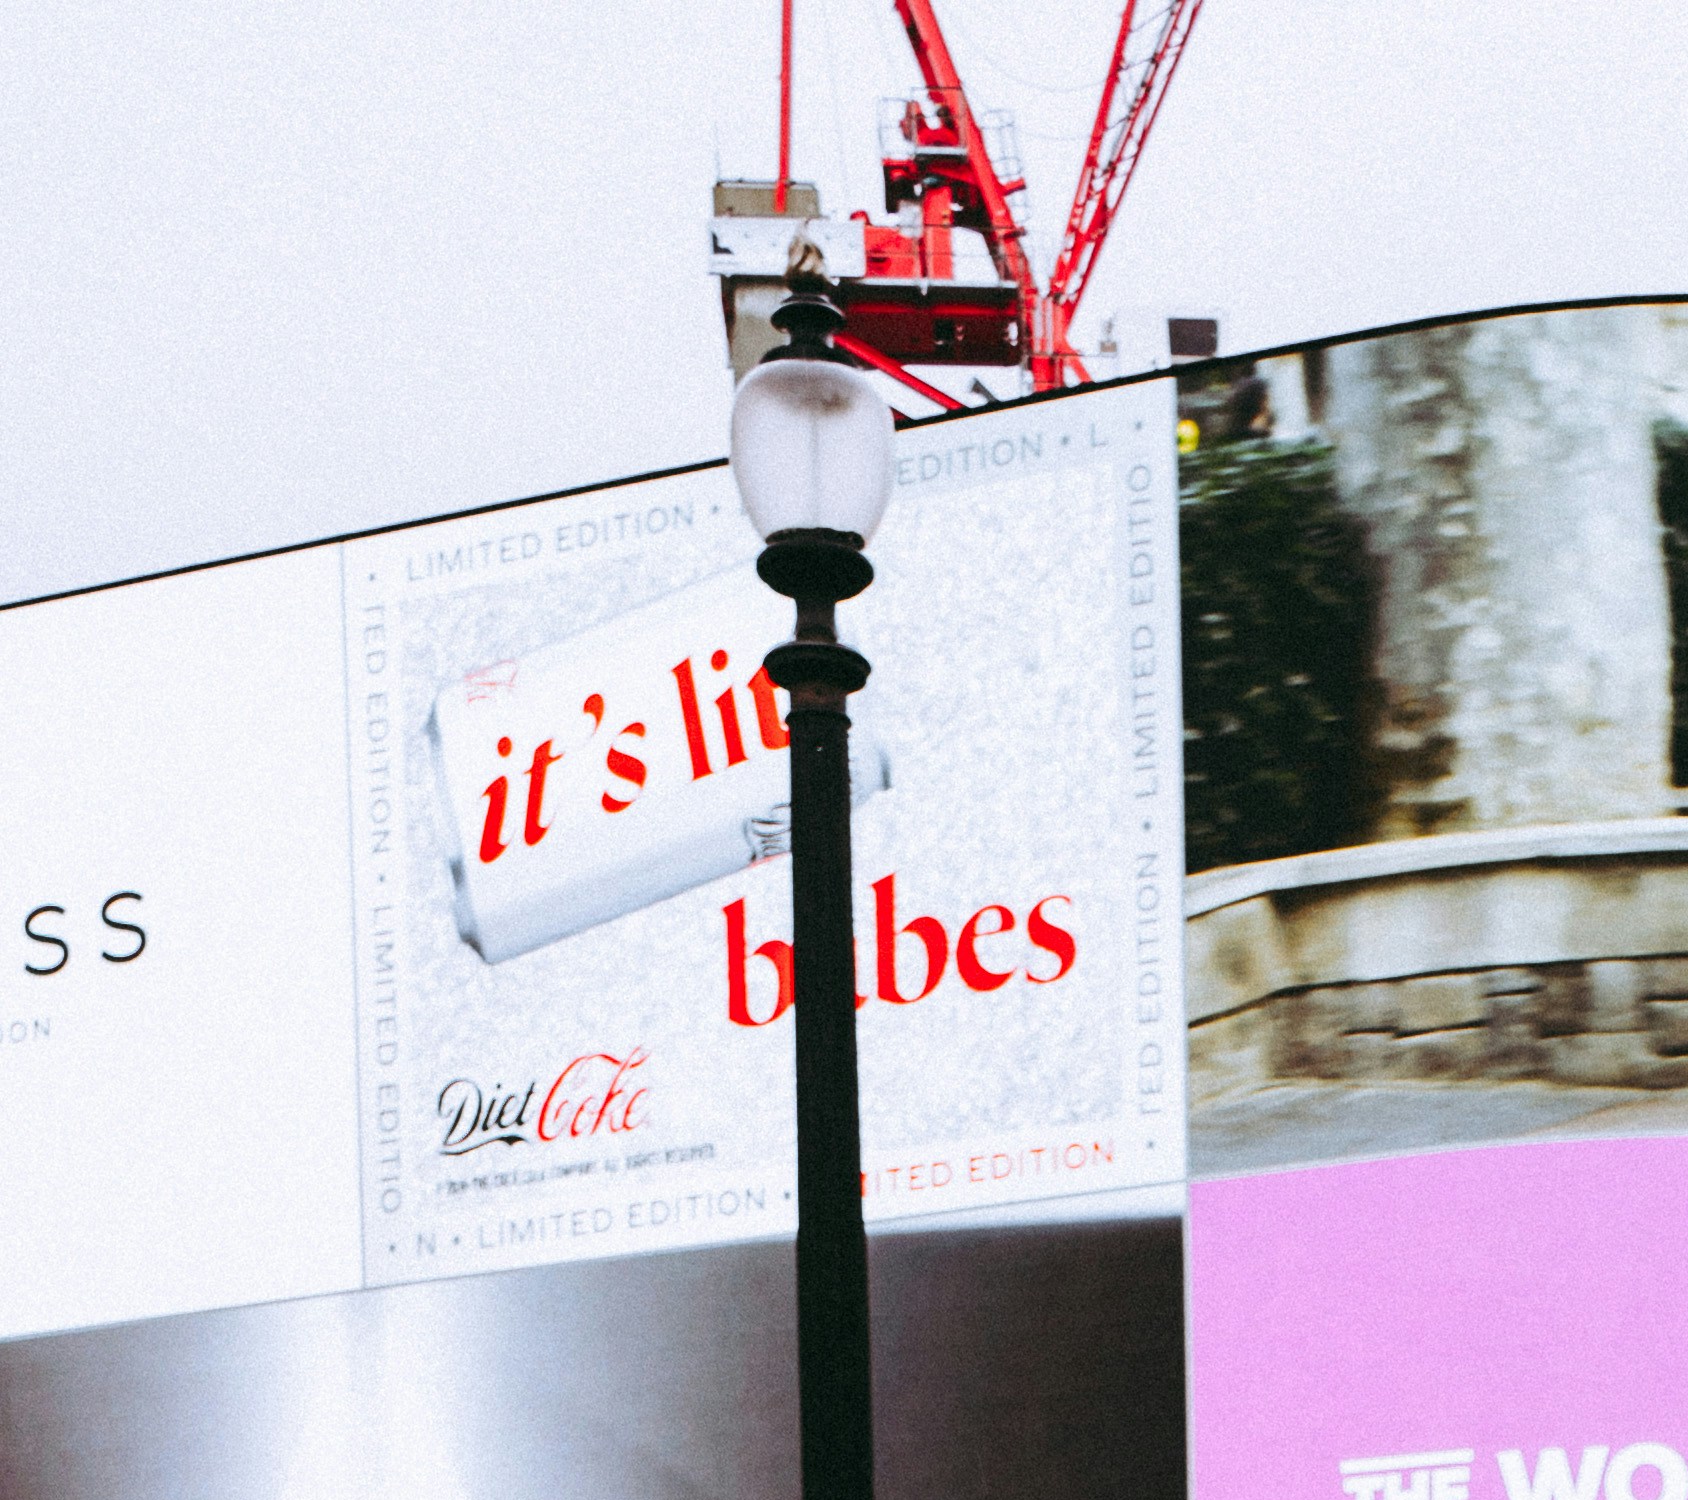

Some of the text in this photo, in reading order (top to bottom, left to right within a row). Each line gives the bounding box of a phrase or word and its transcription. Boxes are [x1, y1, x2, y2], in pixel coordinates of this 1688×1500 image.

[897, 431, 1044, 486] EDITION
[406, 500, 696, 583] LIMITED EDITION
[722, 872, 1076, 1027] bbes
[438, 1045, 651, 1155] Diet Coke
[969, 1138, 1115, 1184] EDITION
[478, 1207, 614, 1249] LIMITED
[627, 1187, 767, 1229] EDITION
